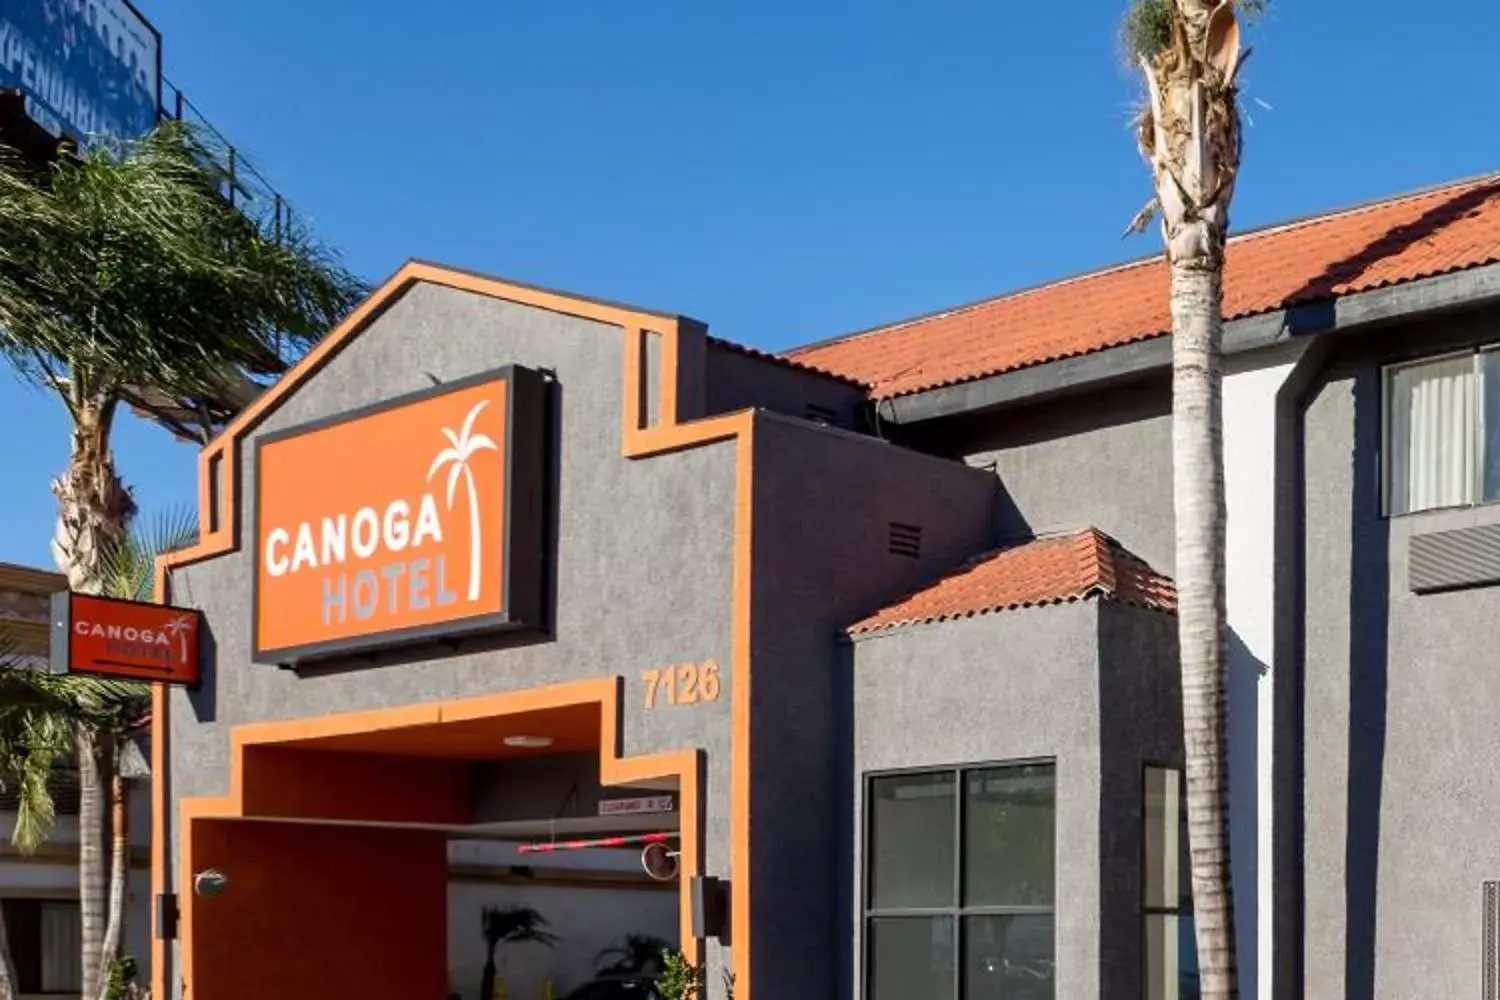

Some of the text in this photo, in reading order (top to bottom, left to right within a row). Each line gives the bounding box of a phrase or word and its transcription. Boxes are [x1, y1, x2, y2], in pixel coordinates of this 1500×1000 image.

[265, 493, 443, 577] CANOGA
[321, 555, 457, 626] HOTEL
[75, 621, 170, 645] CANOGA
[641, 658, 721, 708] 7126
